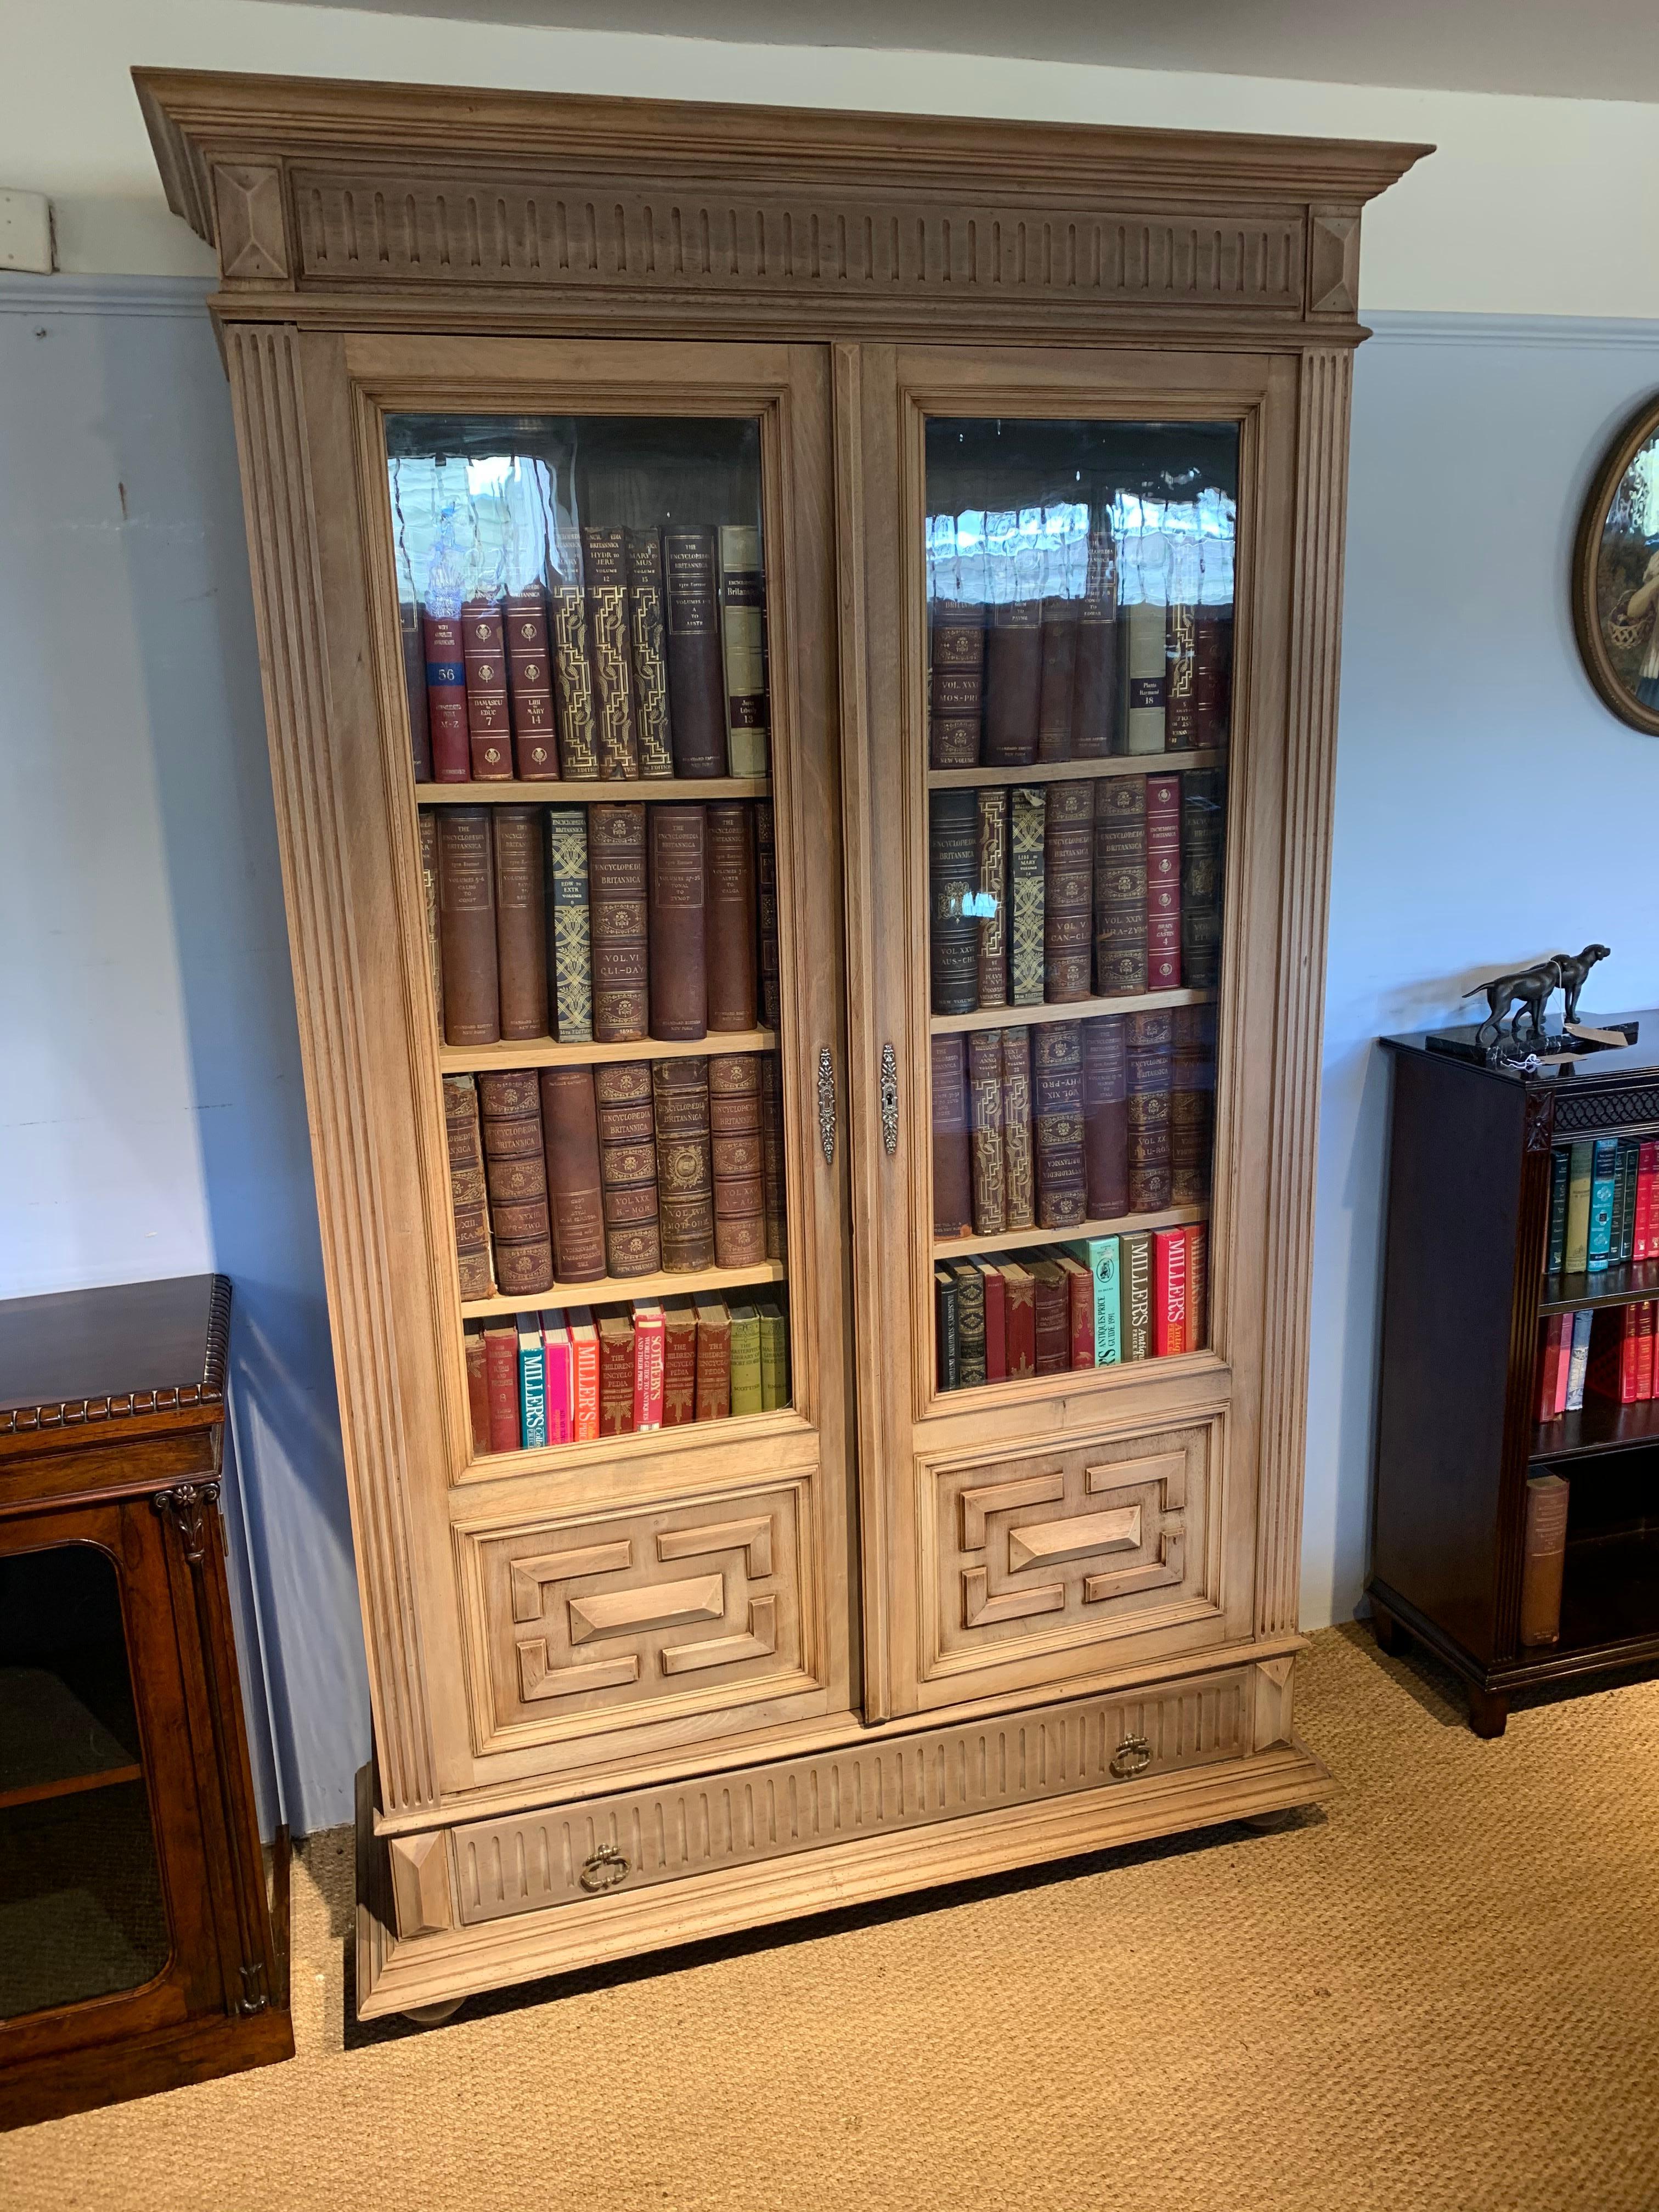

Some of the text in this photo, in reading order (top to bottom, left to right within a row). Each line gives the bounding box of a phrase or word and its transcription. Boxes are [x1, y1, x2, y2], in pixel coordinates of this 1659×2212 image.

[486, 717, 492, 726] 7
[532, 716, 541, 724] 14
[744, 715, 753, 724] 13
[1107, 843, 1142, 851] BRITANNICA
[940, 851, 974, 860] BRITANNICA
[664, 1113, 702, 1123] BRITANNICA
[611, 1124, 648, 1133] BRITANNICA
[1048, 1159, 1081, 1167] BRITANNICA
[1132, 1242, 1148, 1327] MILLER'S
[1167, 1238, 1185, 1323] MILLER'S
[1098, 1315, 1106, 1347] ANTIQUES
[579, 1346, 596, 1421] MILLER'S
[644, 1380, 650, 1390] TO
[524, 1355, 544, 1428] MILLER'S
[500, 1393, 506, 1402] 8
